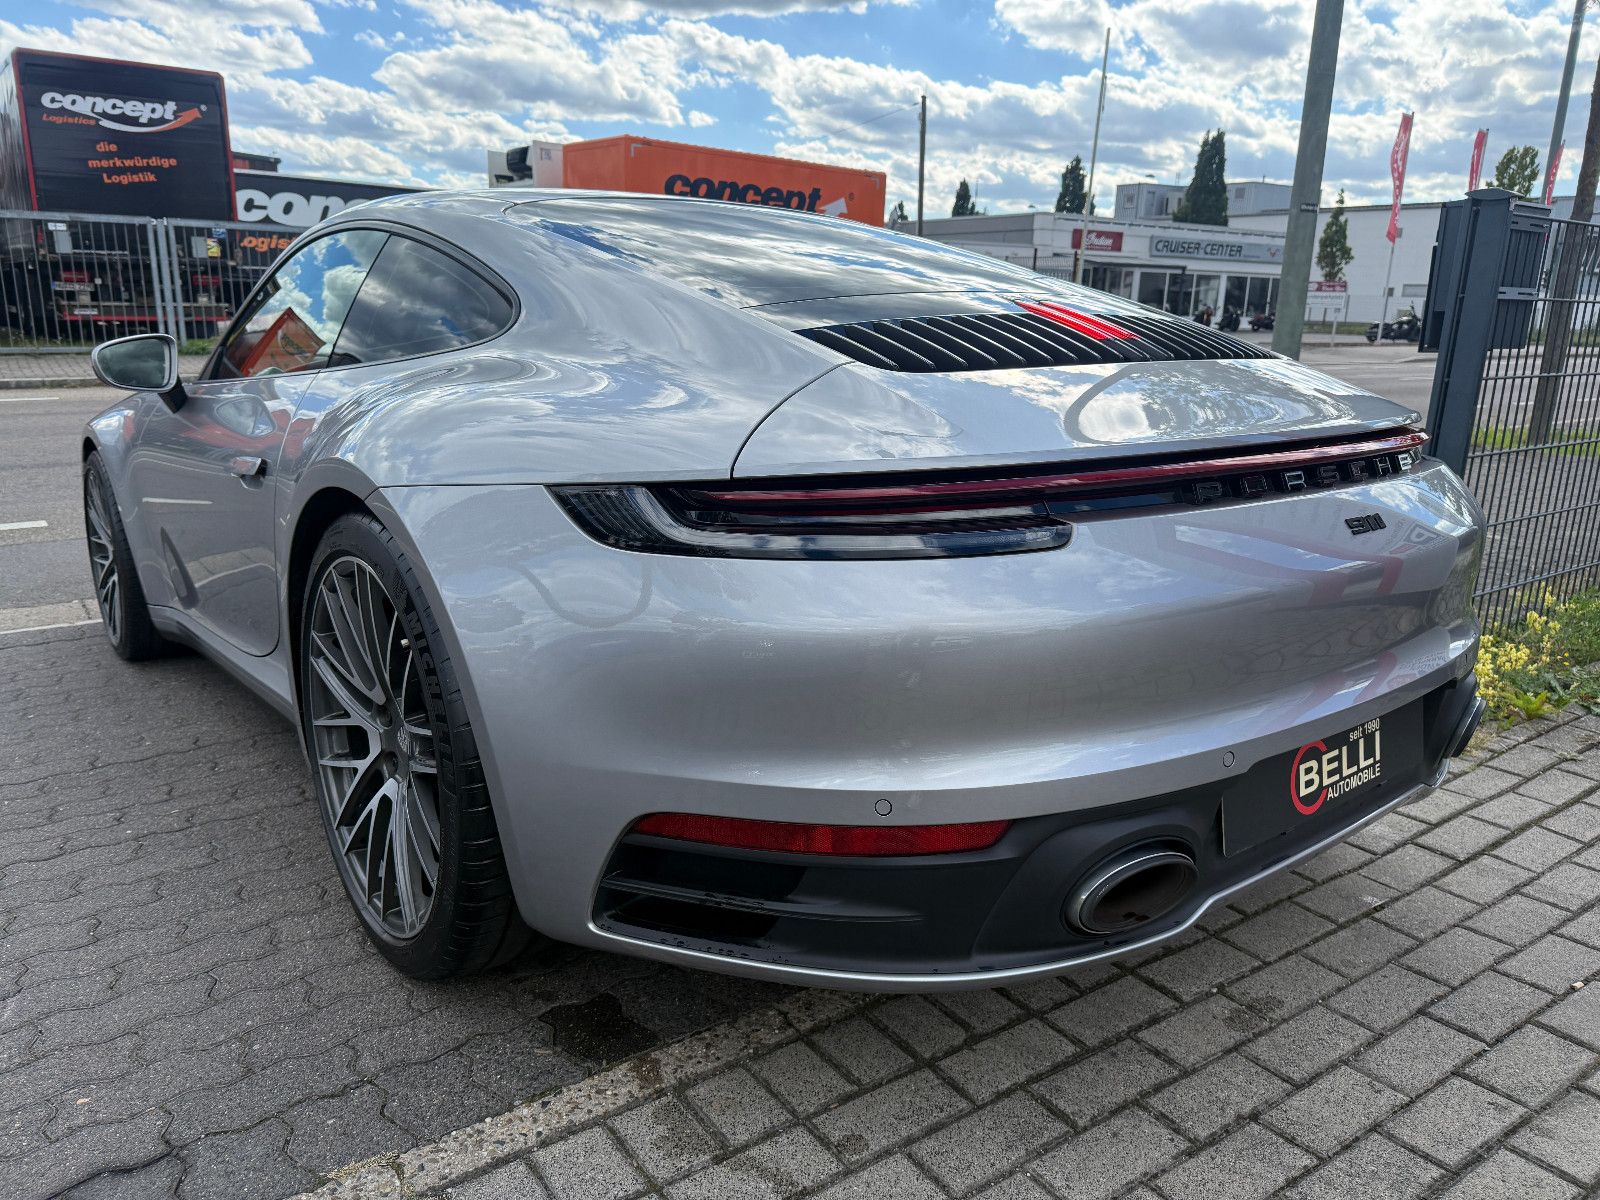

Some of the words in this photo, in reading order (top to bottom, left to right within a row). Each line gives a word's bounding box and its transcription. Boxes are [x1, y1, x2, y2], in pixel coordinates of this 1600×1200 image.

[41, 91, 177, 123] concept
[42, 113, 97, 126] Logistics
[96, 141, 118, 152] die
[88, 156, 177, 168] merkwürdige
[103, 172, 157, 185] Logistik
[235, 188, 373, 227] con
[1194, 452, 1411, 503] PORSCHE
[1345, 512, 1386, 535] 911
[1349, 726, 1363, 741] seit
[1364, 717, 1380, 734] 1990
[1299, 730, 1381, 798] BELLI
[1326, 762, 1381, 801] AUTOMOBILE
